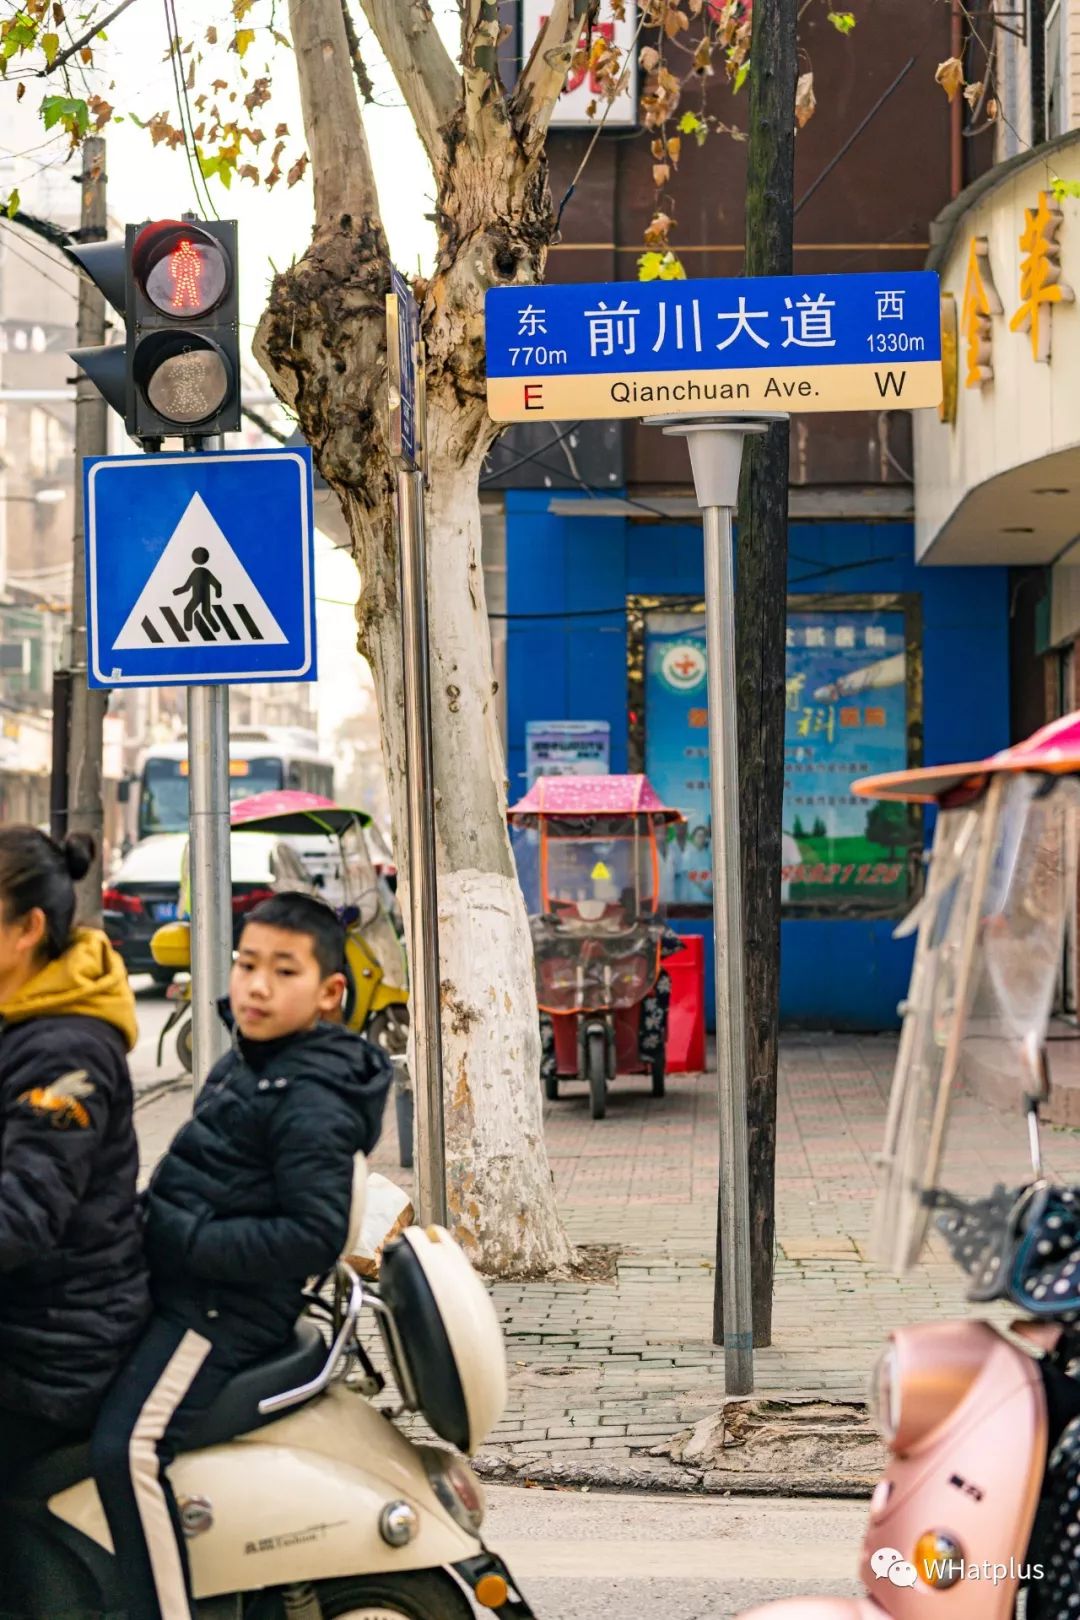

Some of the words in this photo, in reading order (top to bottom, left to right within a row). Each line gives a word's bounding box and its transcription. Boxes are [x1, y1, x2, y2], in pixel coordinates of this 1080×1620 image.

[874, 290, 906, 321] 西
[517, 304, 547, 337] 东
[583, 293, 837, 357] 前川大道
[866, 332, 925, 353] 1330m
[508, 347, 567, 366] 770m
[524, 384, 544, 410] E
[610, 380, 749, 403] Qianchuan
[763, 378, 820, 399] Ave.
[874, 370, 906, 398] W
